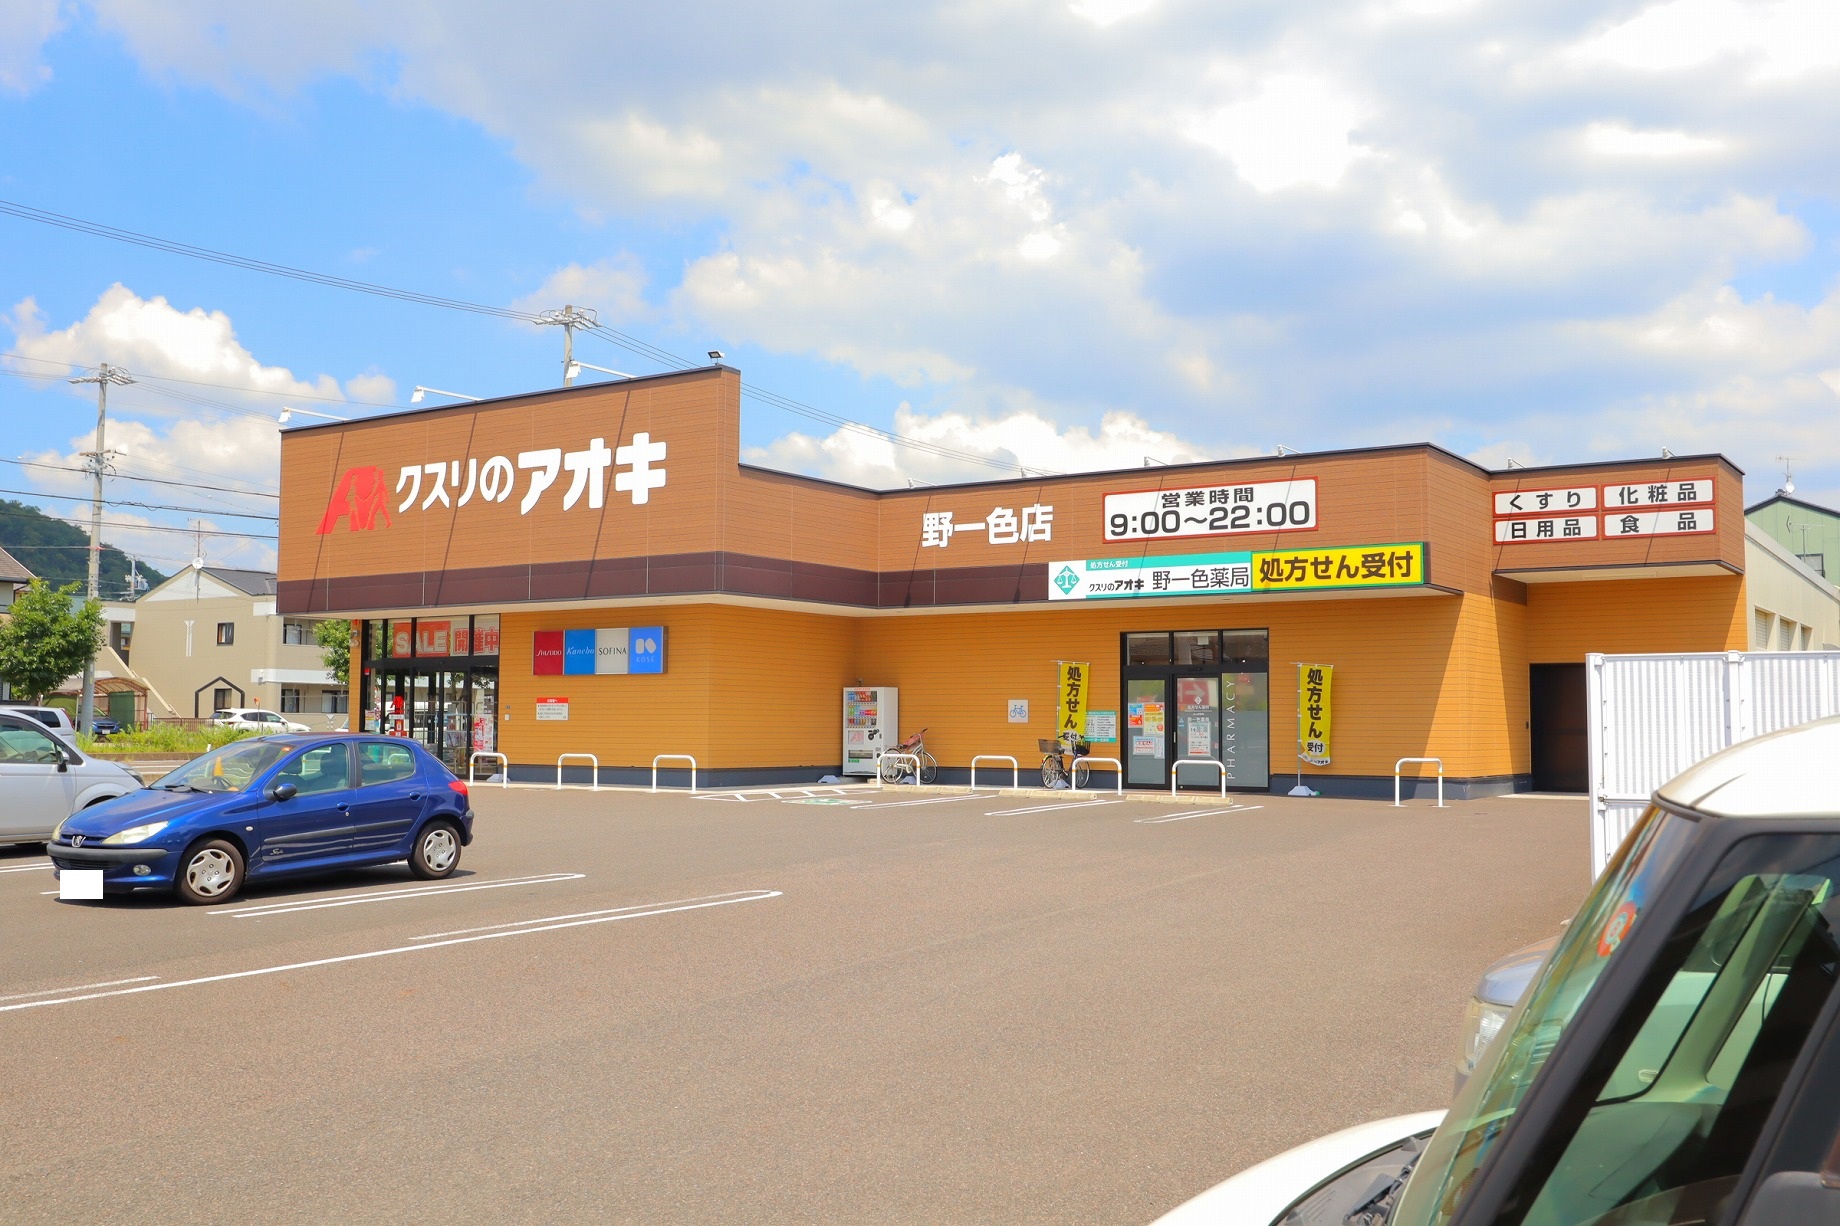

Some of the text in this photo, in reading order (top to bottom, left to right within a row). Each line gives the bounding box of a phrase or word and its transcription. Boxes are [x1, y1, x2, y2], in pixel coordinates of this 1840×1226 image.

[396, 432, 667, 515] クスリのアオキ
[1161, 487, 1254, 508] 営業時間
[1509, 491, 1582, 511] くすり
[1618, 482, 1697, 505] 化粧品
[921, 503, 1054, 548] 野一色店
[1511, 518, 1581, 539] 日用品
[1619, 512, 1697, 534] 食品
[1089, 560, 1129, 569] 処方せん受付
[1259, 550, 1414, 584] 処方せん受付
[1088, 578, 1145, 592] クスリのアオキ
[1152, 566, 1249, 591] 野一色薬局
[566, 646, 595, 655] Kanebo
[598, 647, 627, 655] SOFINA
[1064, 665, 1082, 730] 処方せん
[1306, 668, 1324, 739] 処方せん
[1226, 680, 1236, 780] PHARMACY
[1307, 741, 1324, 753] 受付
